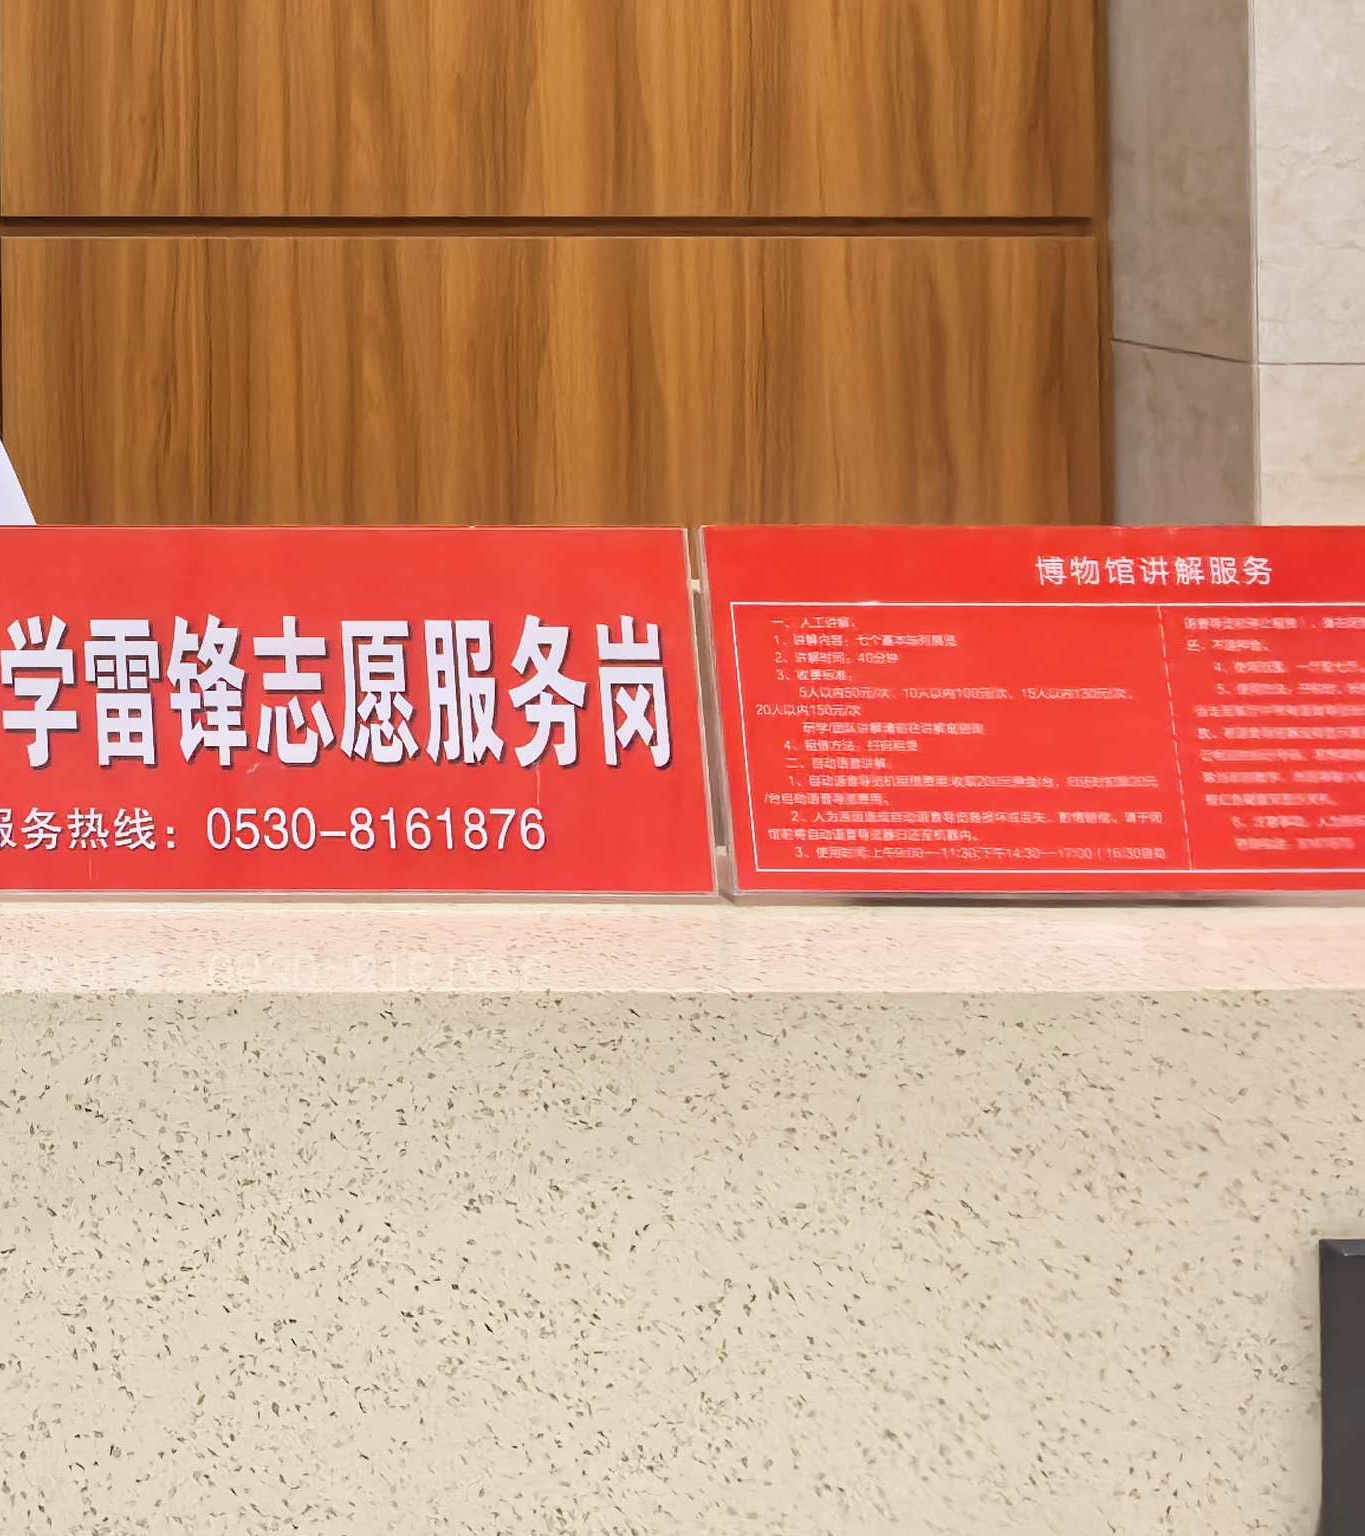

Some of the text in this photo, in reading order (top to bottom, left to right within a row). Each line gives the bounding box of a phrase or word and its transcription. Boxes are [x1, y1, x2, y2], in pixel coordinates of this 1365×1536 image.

[1034, 555, 1274, 587] 博物馆讲解服务
[0, 614, 672, 770] 学雷锋志愿服务岗
